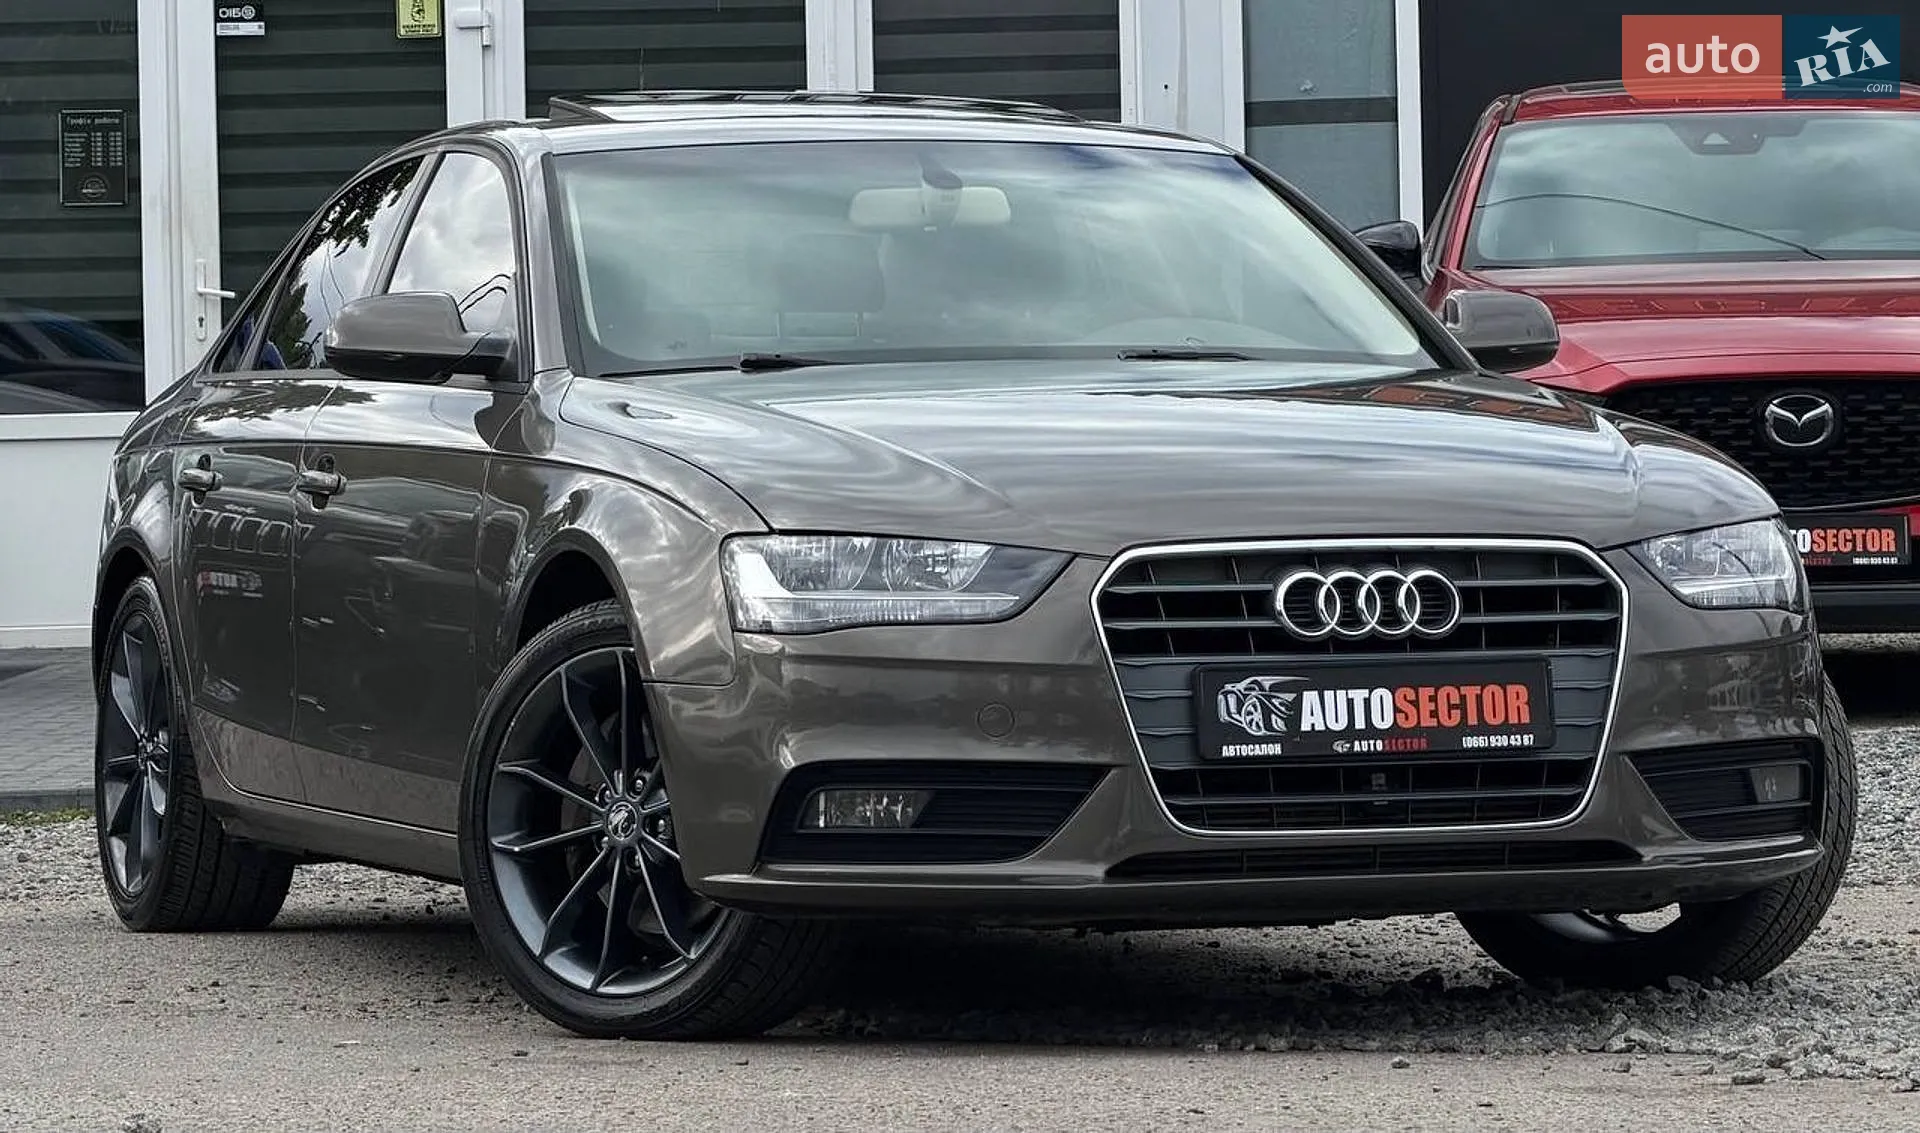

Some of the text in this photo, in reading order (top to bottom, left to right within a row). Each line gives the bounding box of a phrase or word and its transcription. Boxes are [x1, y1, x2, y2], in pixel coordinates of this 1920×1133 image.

[1300, 684, 1531, 732] AUTOSECTOR
[1462, 736, 1488, 749] (066)
[1489, 735, 1509, 747] 930
[1509, 734, 1522, 746] 43
[1222, 743, 1282, 757] АВТОСАЛОН
